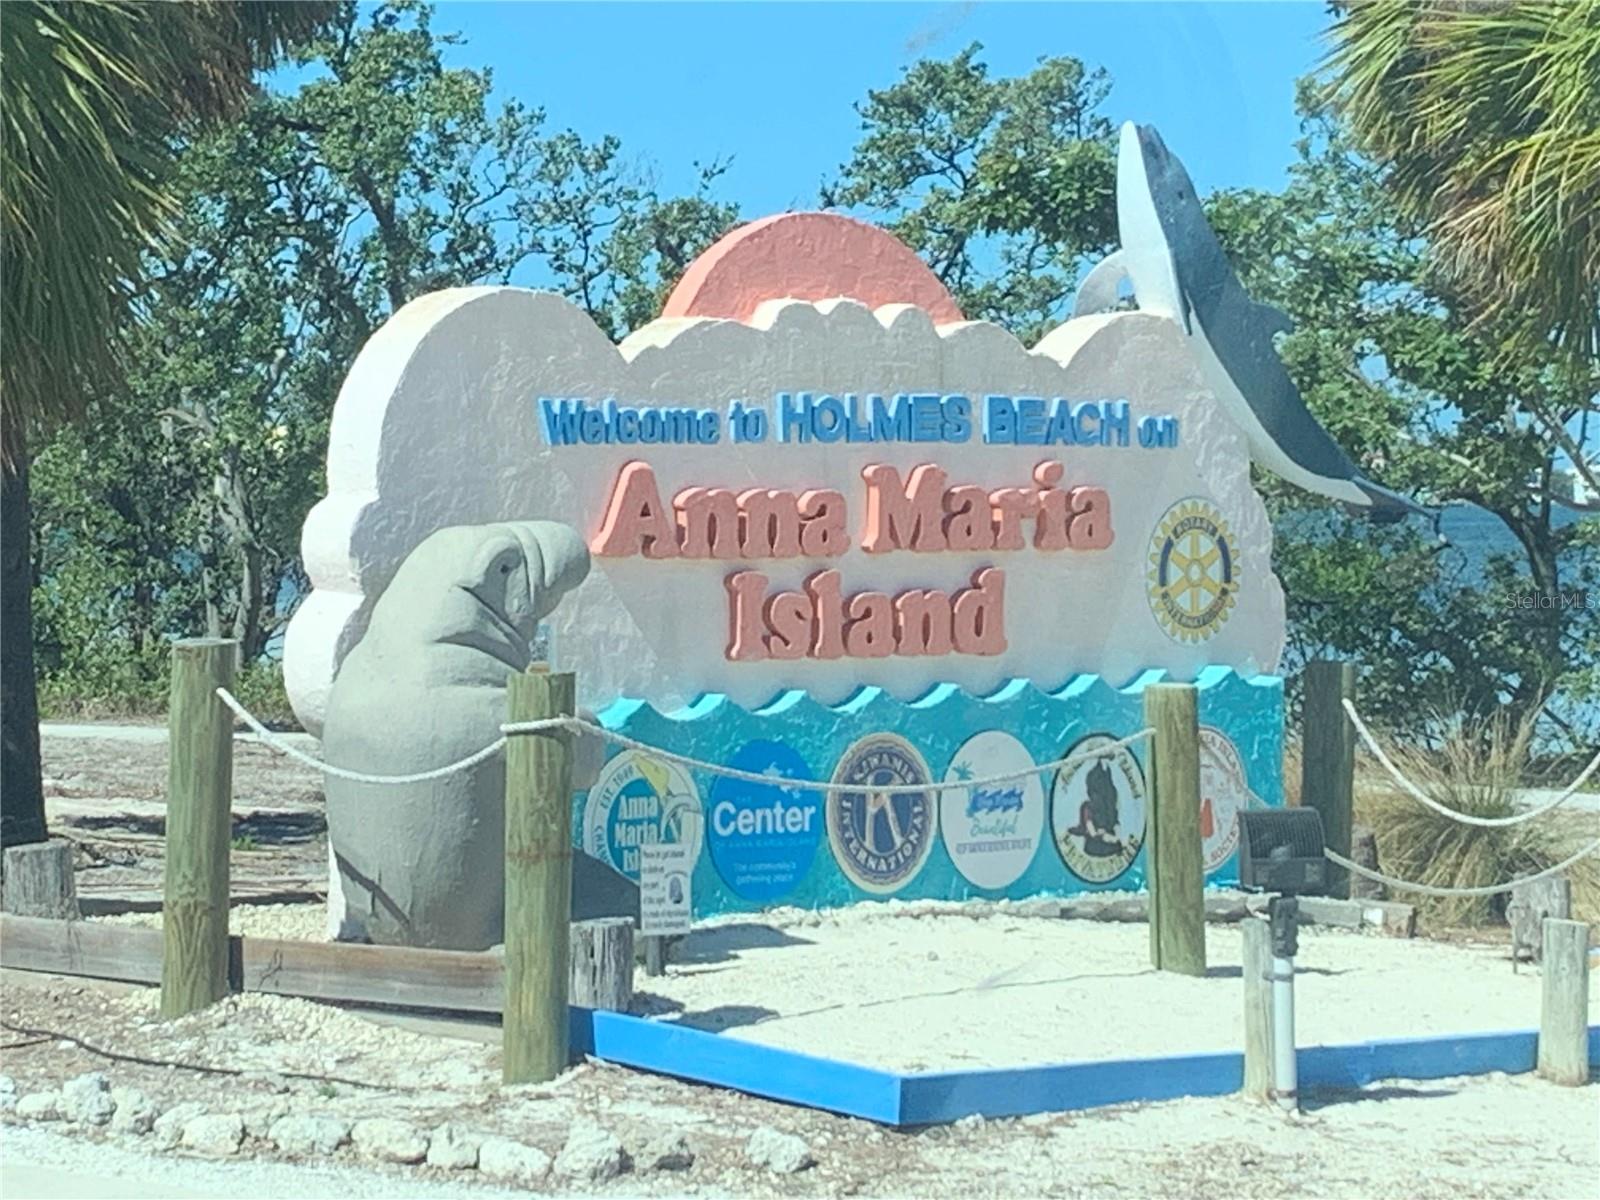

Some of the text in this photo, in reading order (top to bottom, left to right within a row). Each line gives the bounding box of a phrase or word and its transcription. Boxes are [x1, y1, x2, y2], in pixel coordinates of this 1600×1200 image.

[538, 391, 1179, 449] Welcome to HOLMES BEACH on
[589, 459, 1115, 559] Anna Maria
[724, 567, 1008, 661] Island
[853, 753, 914, 784] KIWANIS
[618, 795, 660, 820] Anna
[713, 800, 816, 837] Center
[614, 821, 660, 848] Maria
[841, 800, 923, 871] INTERNATIONAL
[623, 848, 641, 872] Isl
